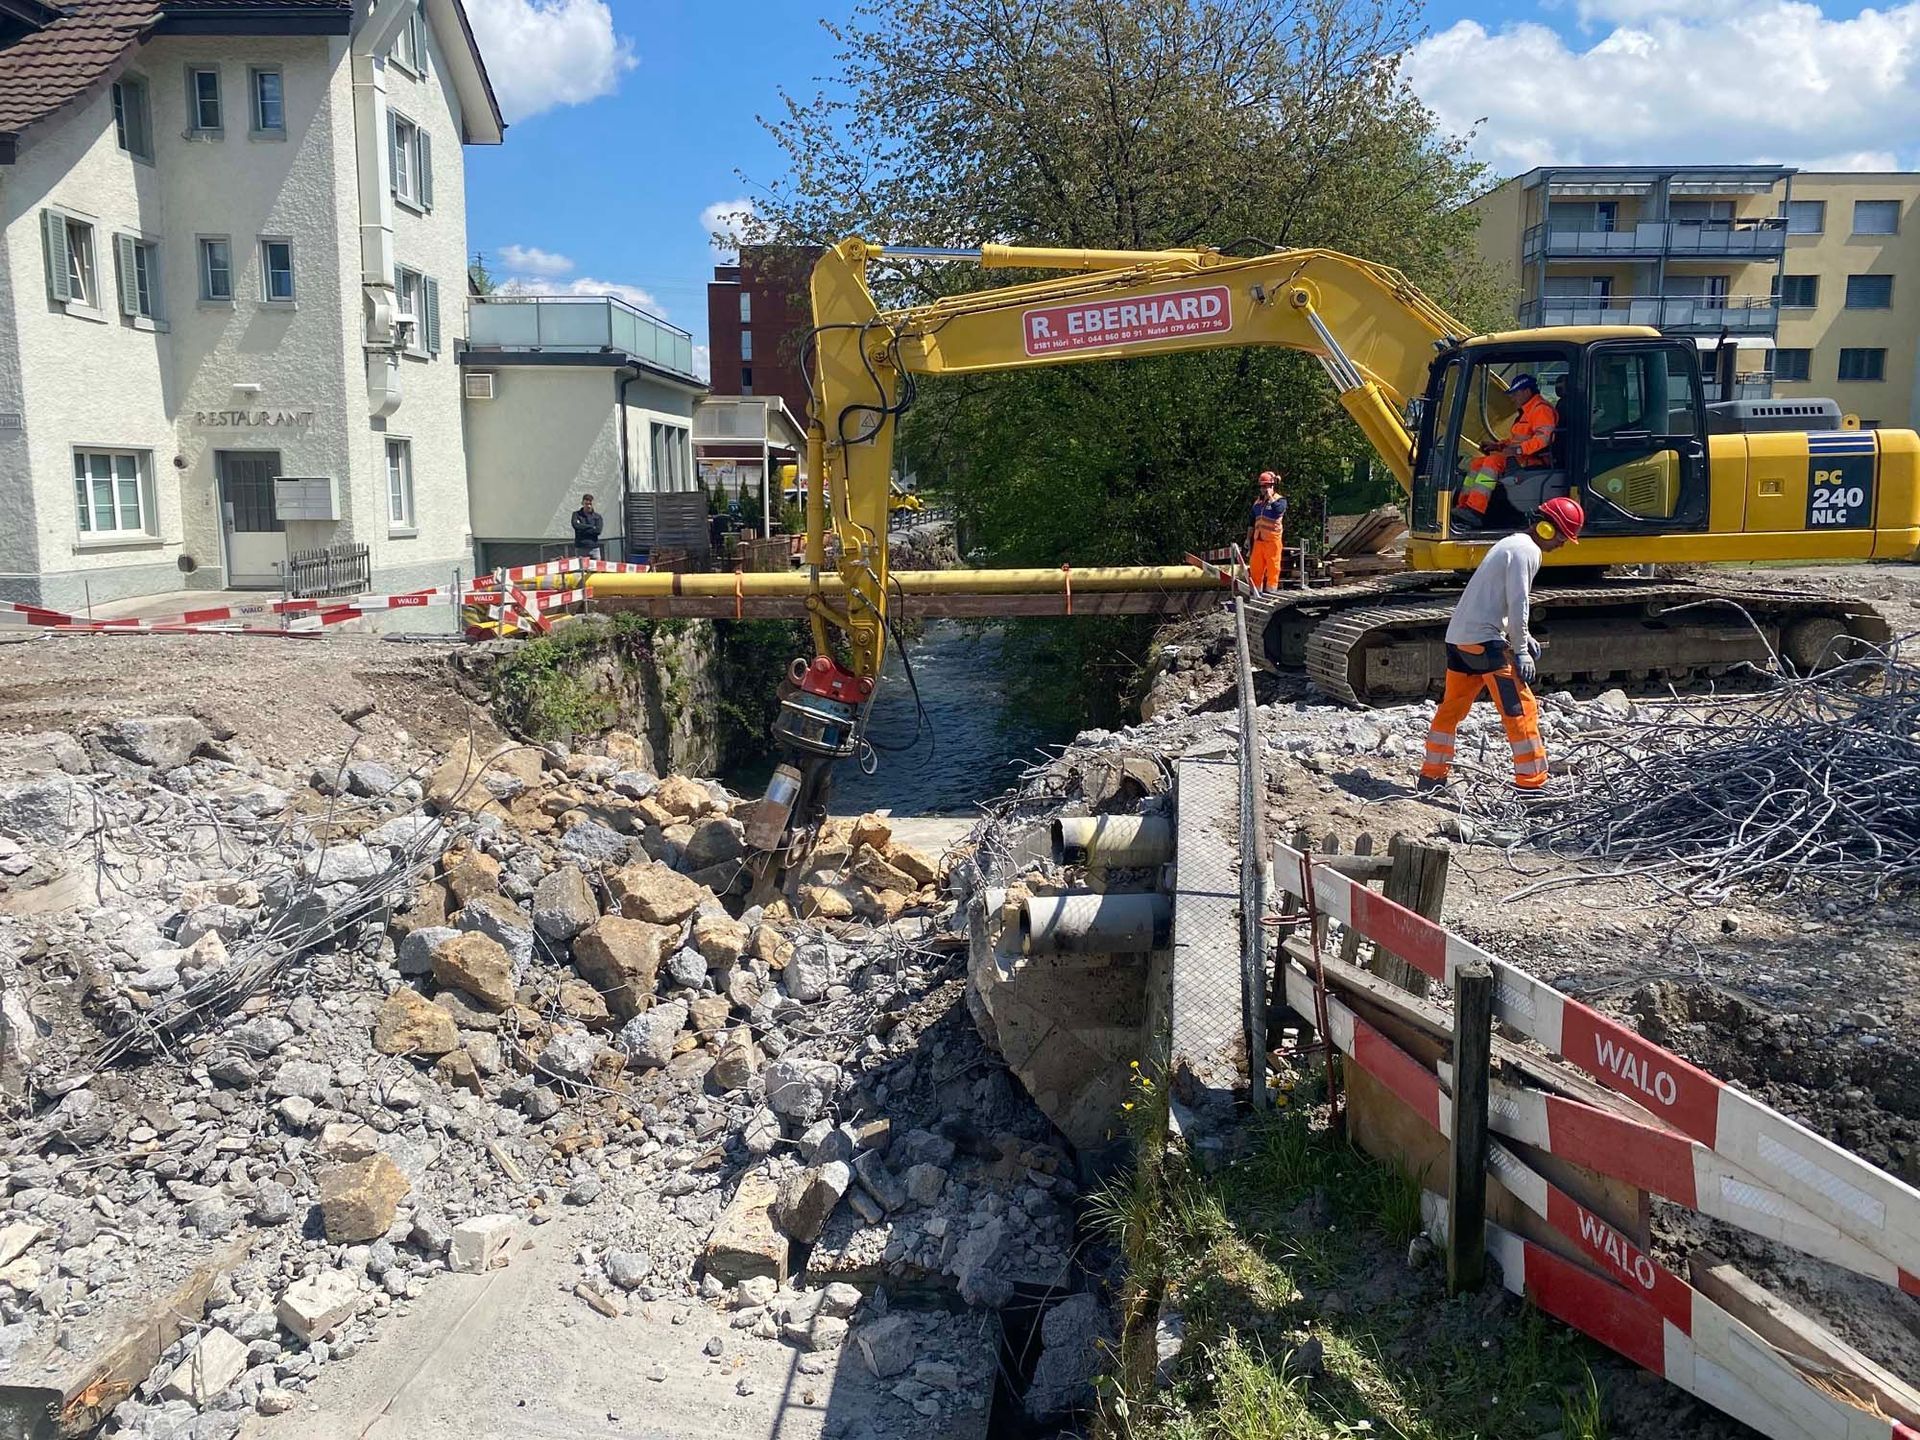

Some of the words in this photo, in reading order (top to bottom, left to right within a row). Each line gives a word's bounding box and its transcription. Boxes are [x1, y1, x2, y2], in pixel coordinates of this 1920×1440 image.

[1031, 316, 1059, 340] R.
[1067, 295, 1222, 335] EBERHARD
[1088, 334, 1102, 343] 044
[1133, 329, 1143, 338] 91
[1147, 325, 1169, 336] Natel
[1170, 324, 1184, 333] 079
[1186, 322, 1200, 331] 661
[1201, 320, 1211, 329] 77
[196, 410, 314, 428] RESTAURANT
[1814, 470, 1843, 486] PC
[1812, 487, 1864, 508] 240
[1811, 509, 1848, 524] NLC
[240, 606, 263, 615] WALO
[397, 597, 419, 605] WALO
[1594, 1032, 1677, 1106] WALO
[1577, 1206, 1656, 1290] WALO
